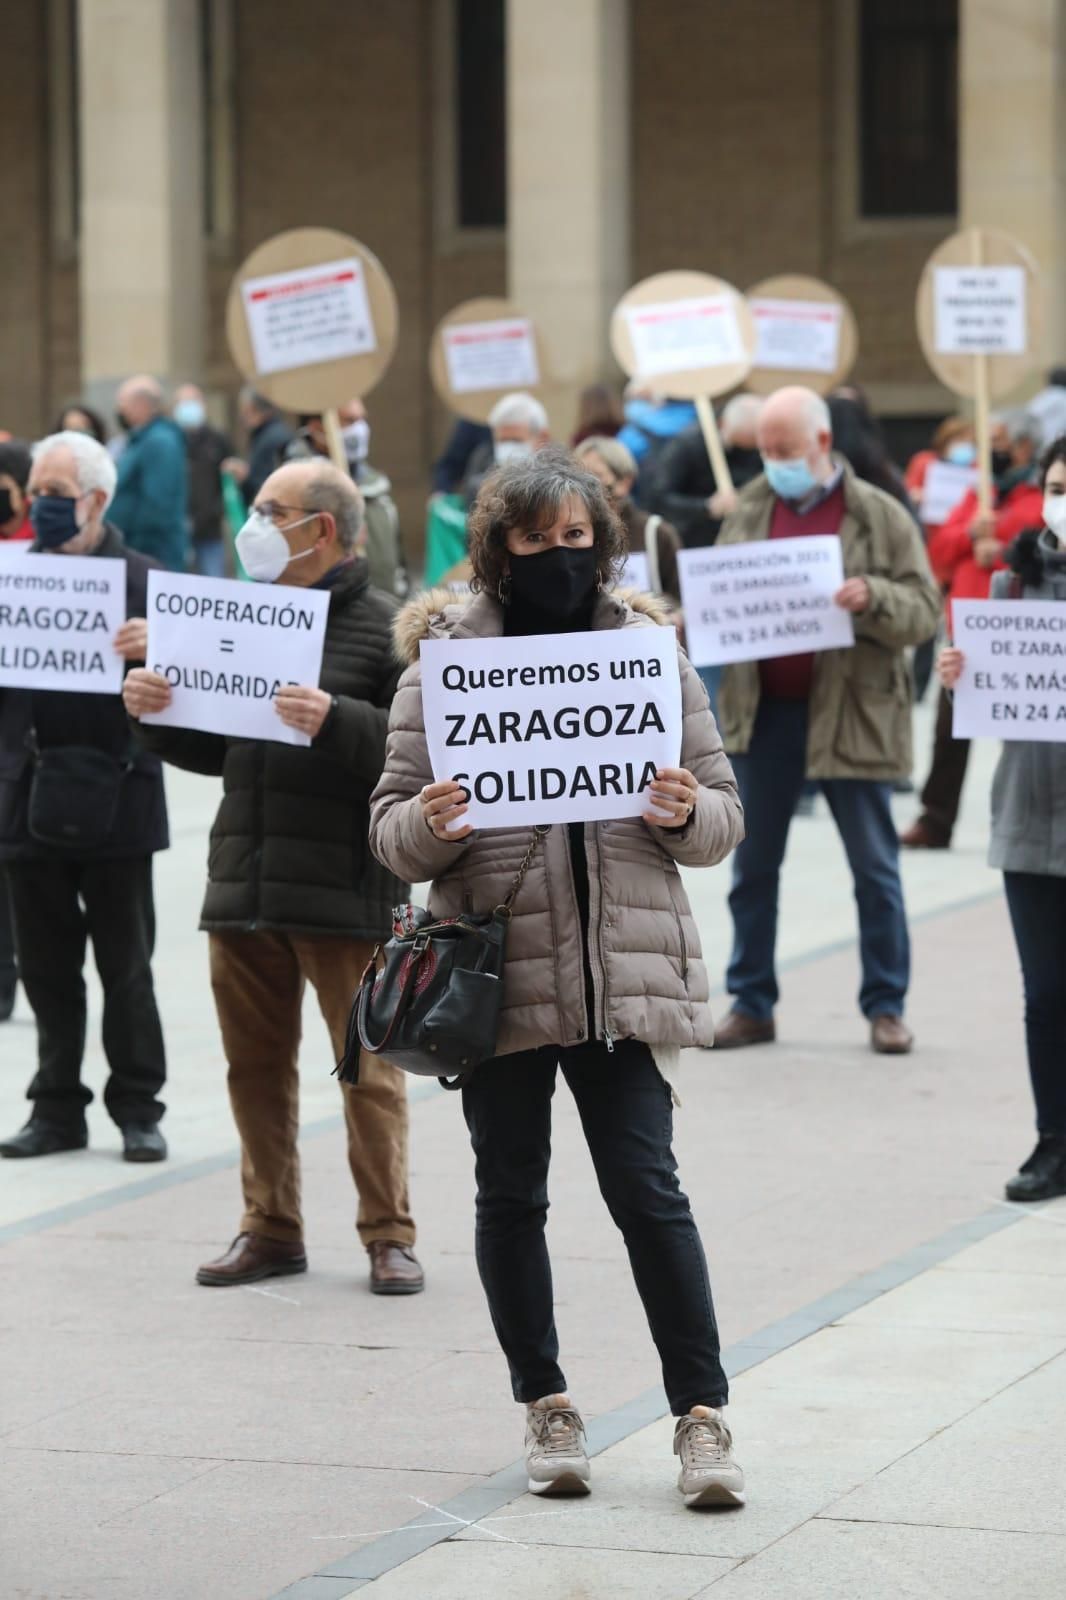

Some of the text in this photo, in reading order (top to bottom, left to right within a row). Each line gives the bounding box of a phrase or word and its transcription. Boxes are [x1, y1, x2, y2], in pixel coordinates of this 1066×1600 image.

[0, 574, 110, 594] remos una
[155, 592, 314, 630] COOPERACIÓN
[220, 639, 234, 653] =
[991, 640, 1066, 656] DE ZARA
[442, 657, 661, 693] Queremos una
[974, 672, 995, 689] EL
[1001, 674, 1019, 690] %
[991, 704, 1018, 720] EN
[1026, 704, 1048, 721] 24
[445, 702, 665, 746] ZARAGOZA
[451, 761, 659, 805] SOLIDARIA
